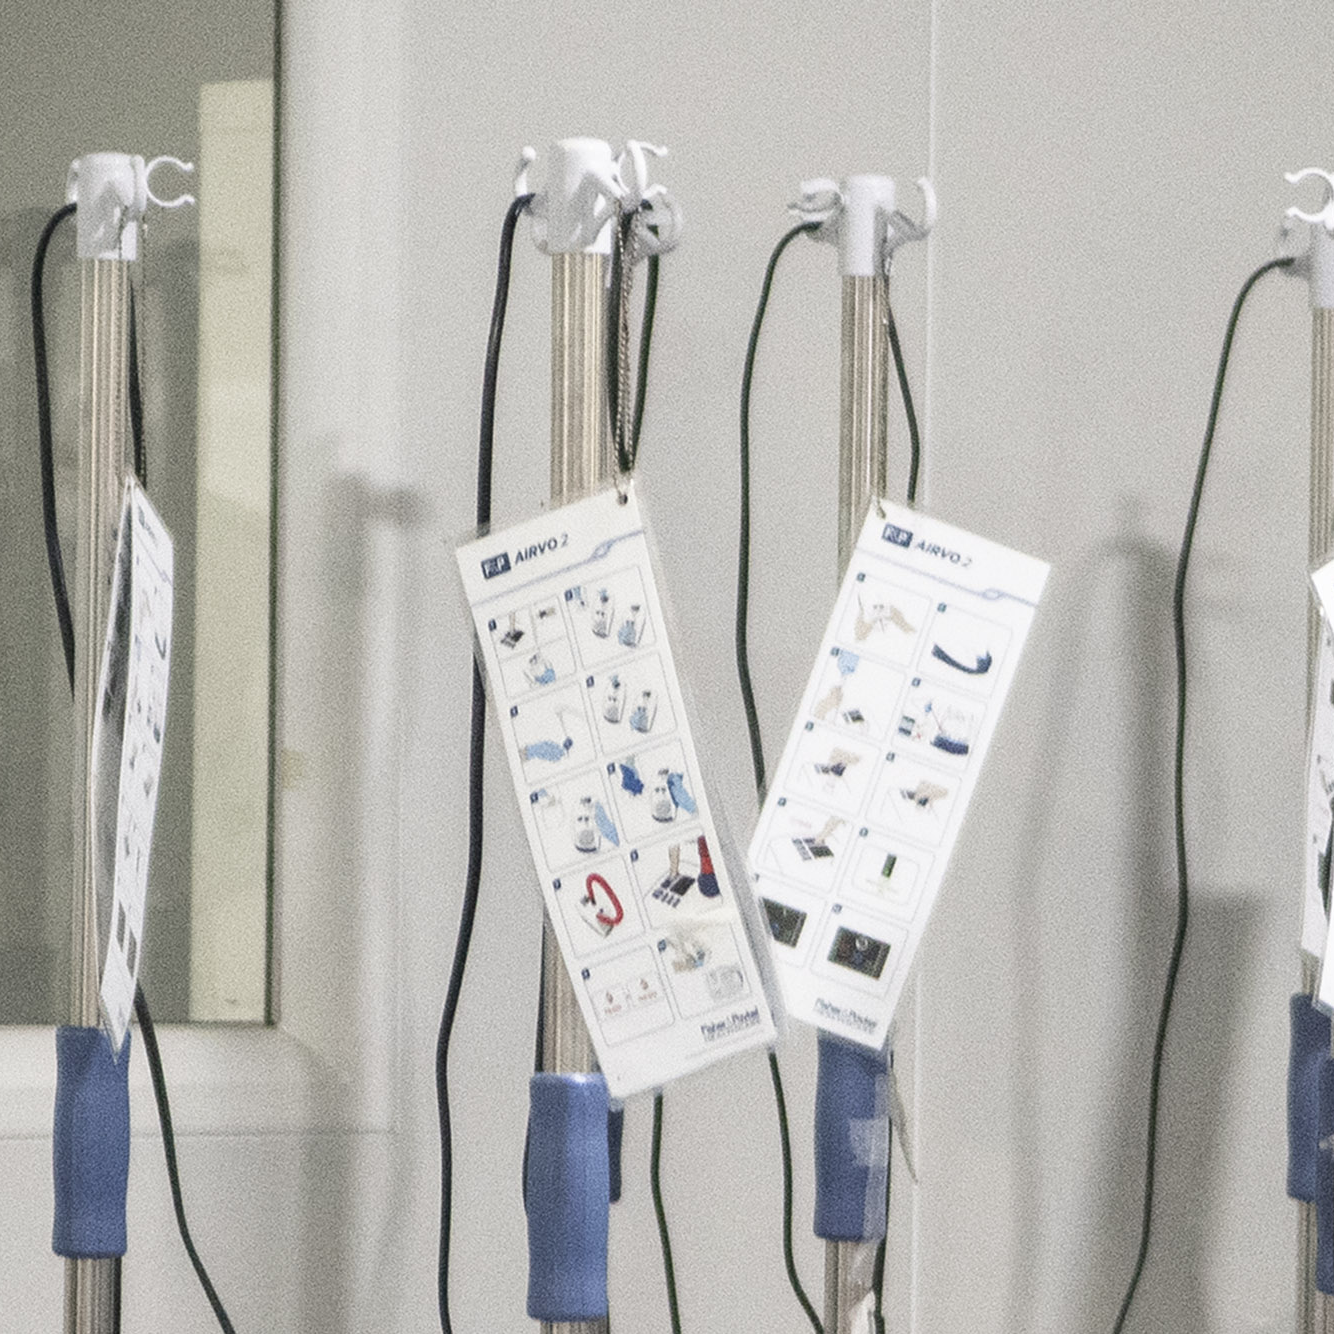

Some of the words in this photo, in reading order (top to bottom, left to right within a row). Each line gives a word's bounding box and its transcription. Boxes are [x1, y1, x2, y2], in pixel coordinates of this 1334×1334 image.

[514, 537, 559, 566] AIRVO
[560, 532, 569, 548] 2
[916, 540, 961, 565] AIRVO
